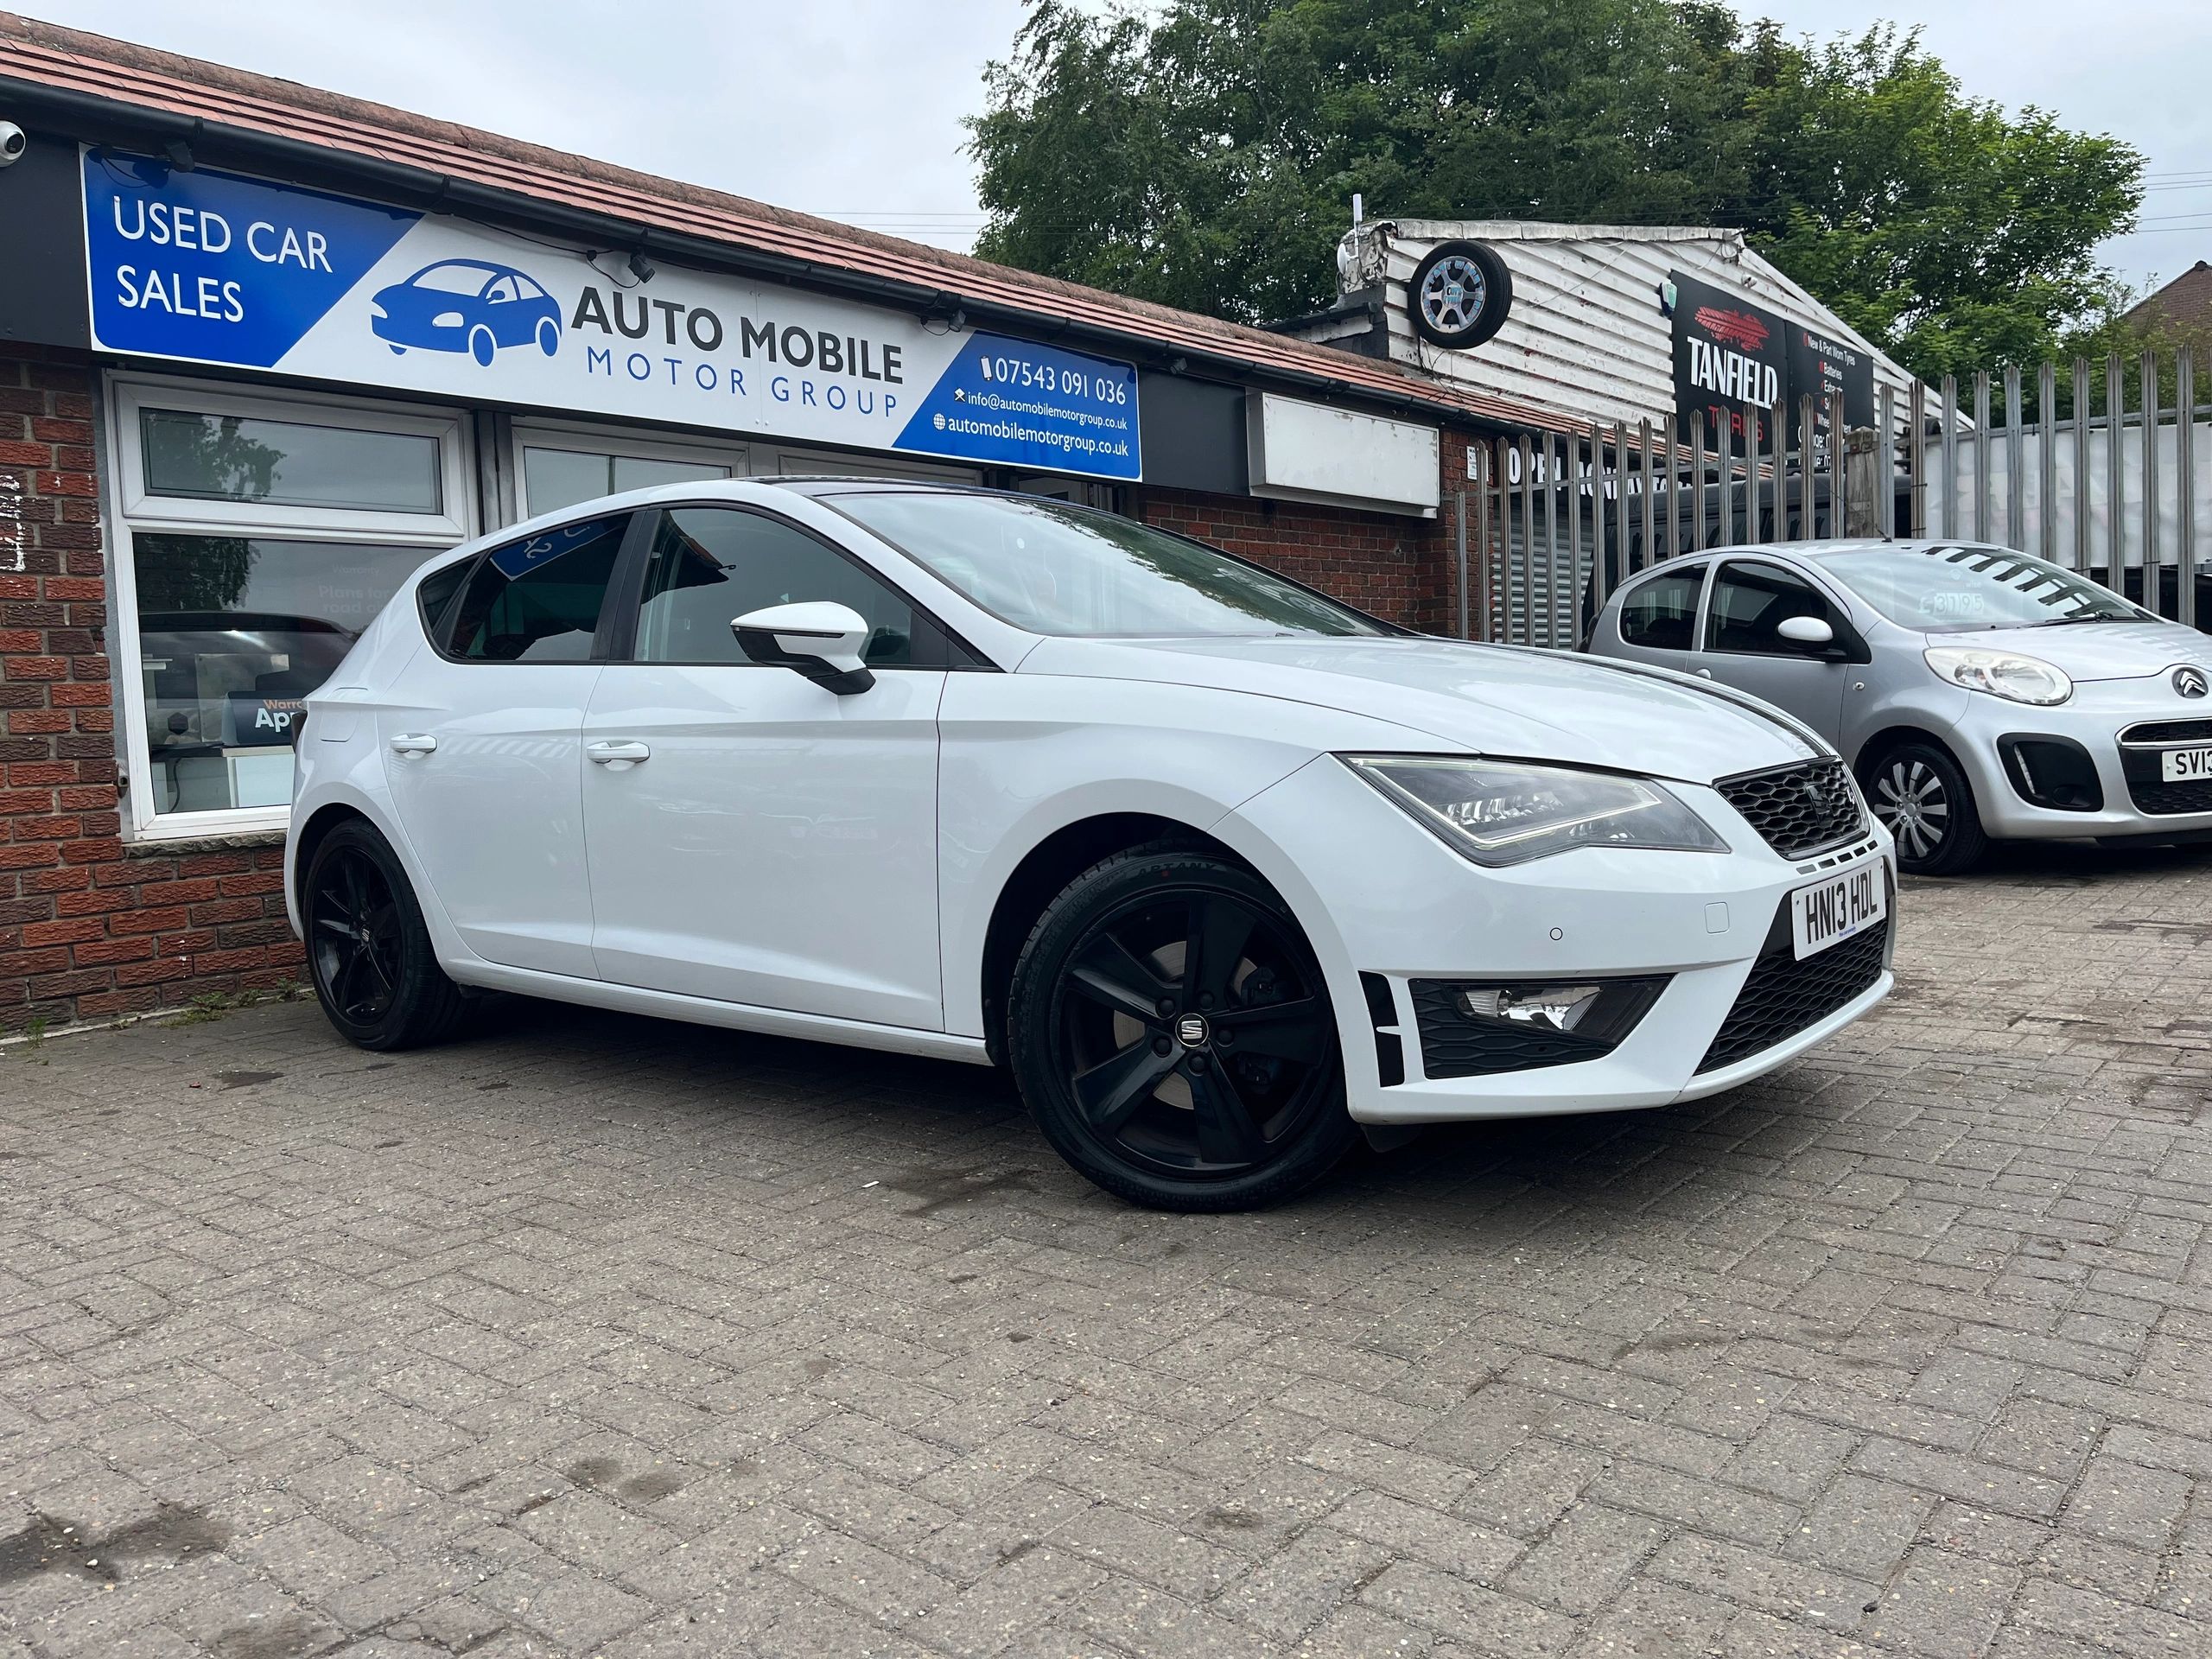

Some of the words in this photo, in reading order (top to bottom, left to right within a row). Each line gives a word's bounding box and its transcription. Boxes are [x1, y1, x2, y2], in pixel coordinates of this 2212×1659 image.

[113, 195, 232, 253] USED
[246, 221, 334, 273] CAR
[117, 264, 244, 322] SALES
[570, 286, 723, 352] AUTO
[741, 316, 903, 385] MOBILE
[588, 346, 747, 396] MOTOR
[771, 377, 897, 417] GROUP
[995, 358, 1056, 391] 07543
[1061, 370, 1089, 397] 091
[1096, 378, 1126, 405] 036
[1687, 335, 1778, 410] TANFIELD
[948, 418, 1128, 456] automobilemotorgroup.co.uk
[968, 391, 1128, 430] info@automobilemotorgroup.co.uk
[1806, 881, 1847, 944] HN13
[1851, 869, 1878, 924] HDL
